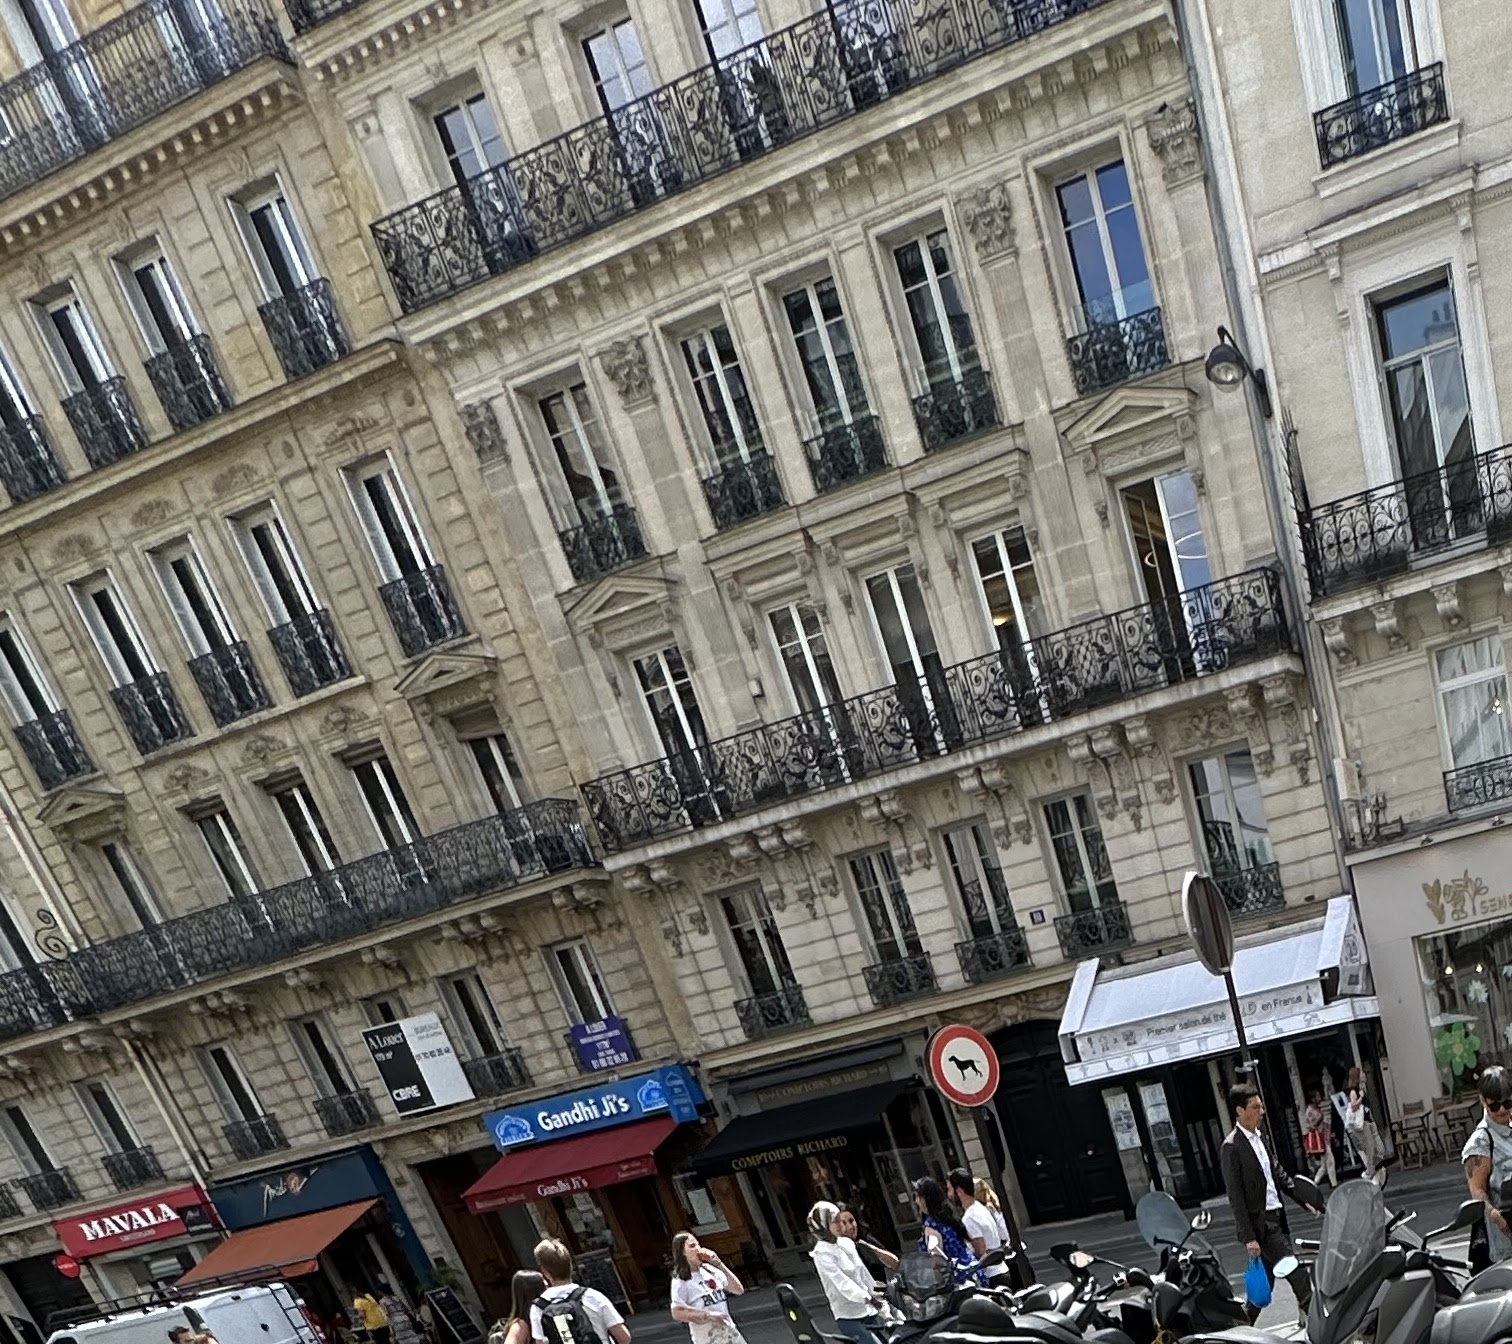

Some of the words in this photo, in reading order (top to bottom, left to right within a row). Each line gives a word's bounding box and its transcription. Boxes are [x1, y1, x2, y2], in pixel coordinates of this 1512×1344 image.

[537, 1099, 601, 1132] Gandhi
[602, 1093, 631, 1117] Ji's
[731, 1146, 794, 1171] COMPTOIRS
[798, 1135, 848, 1155] RICHARD
[536, 1179, 571, 1197] Gandhi
[79, 1202, 181, 1241] MAVALA
